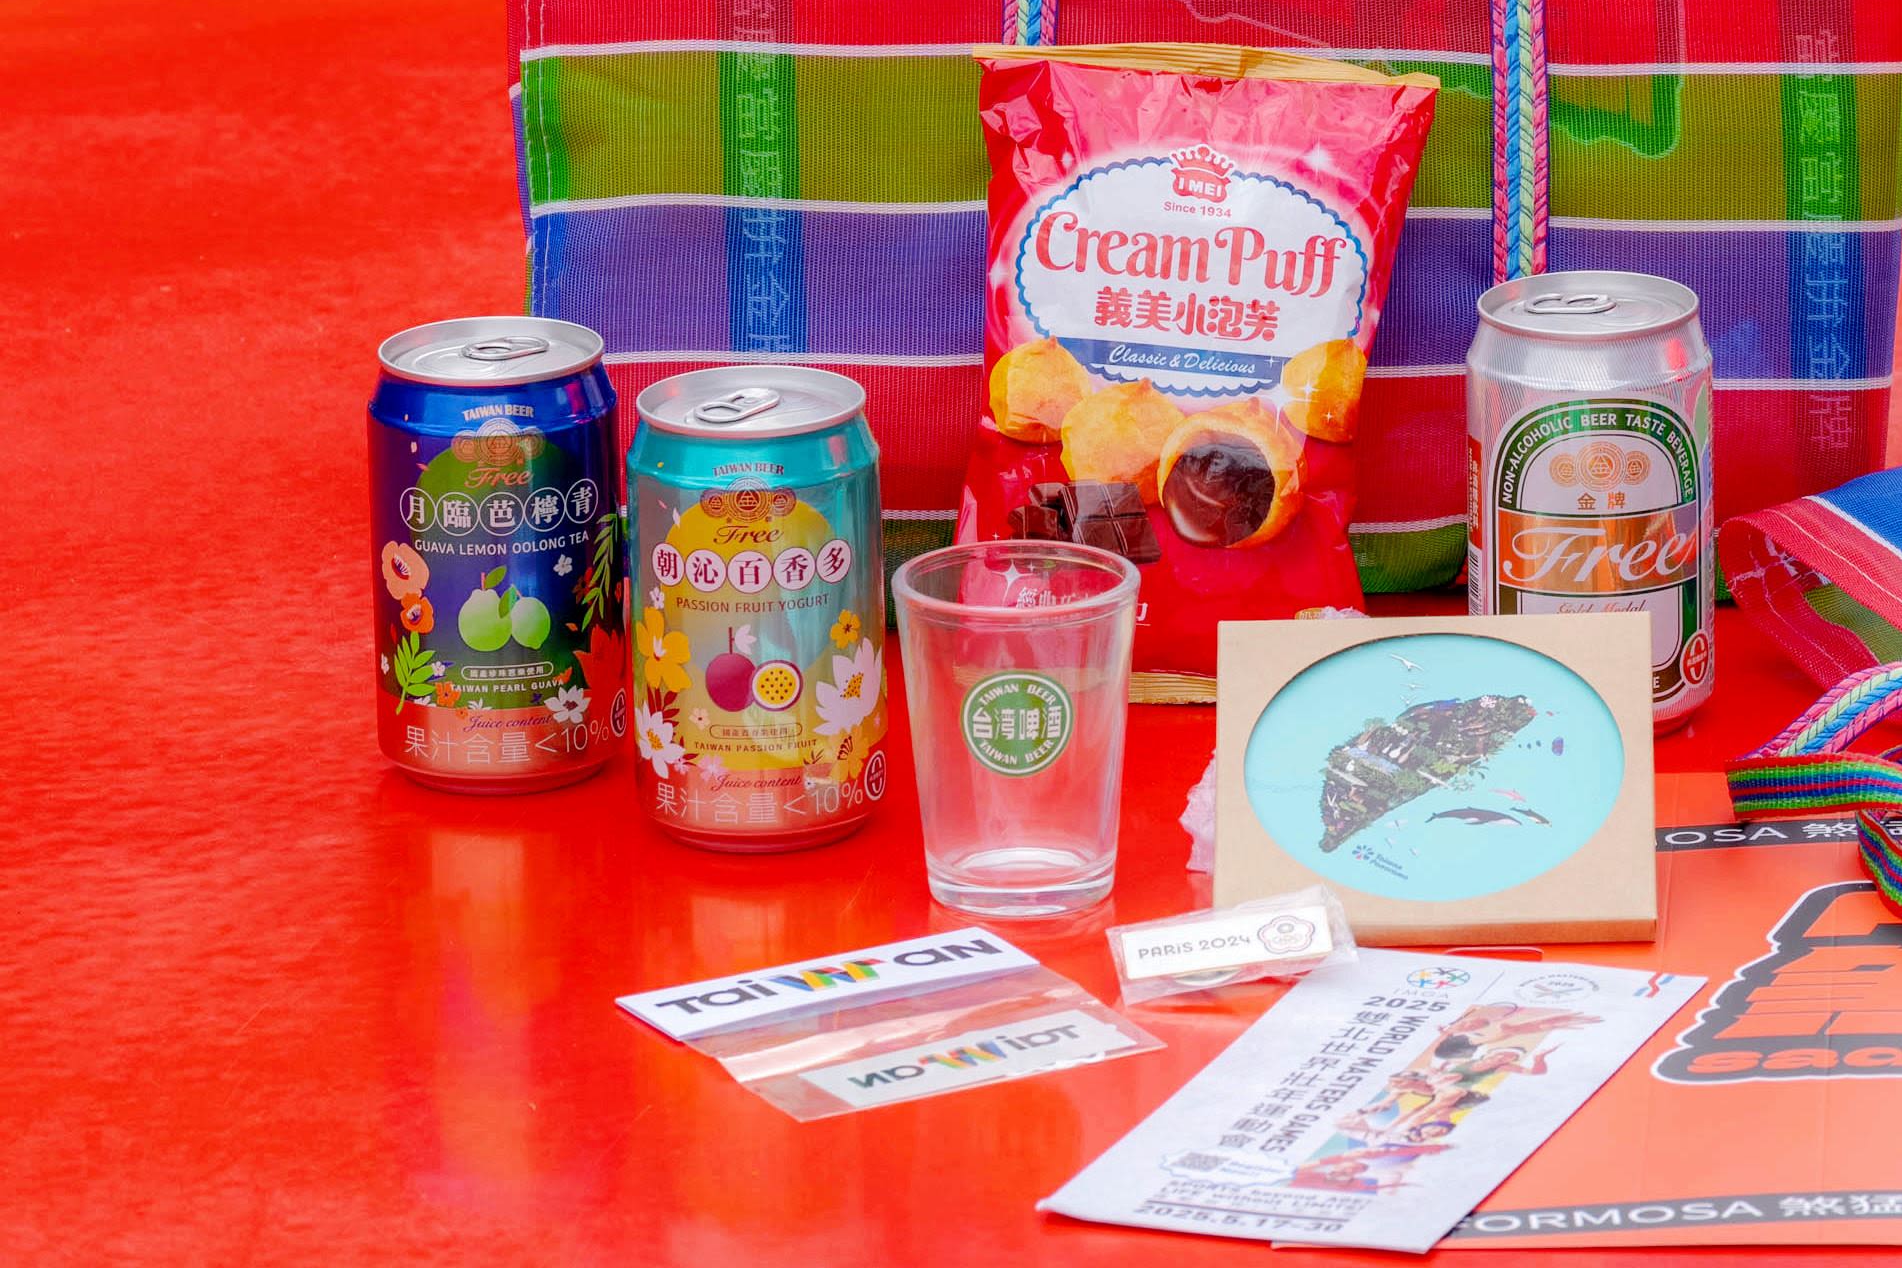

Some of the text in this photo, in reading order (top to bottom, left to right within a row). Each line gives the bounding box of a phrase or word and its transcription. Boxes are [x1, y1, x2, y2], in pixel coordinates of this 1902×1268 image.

[1163, 200, 1232, 218] Since 1934
[1036, 211, 1347, 298] Cream Puff
[1094, 285, 1281, 342] 義美小泡芙
[1108, 343, 1256, 375] Classic & Delicious
[462, 404, 534, 421] TAIWAN BEER
[713, 462, 785, 477] TAIWAN BEER
[1502, 416, 1573, 504] NON-ALCOHOLIC
[1581, 413, 1618, 428] BEER
[1625, 412, 1665, 436] TASTE
[1667, 430, 1694, 498] BEVERAGE
[464, 466, 535, 489] Free
[405, 486, 593, 528] 月臨芭檸青
[414, 531, 590, 556] GUAVA LEMON OOLONG TEA
[712, 524, 785, 545] Free
[1502, 524, 1697, 583] Free
[656, 547, 845, 585] 朝沁百香多
[676, 593, 830, 613] PASSION FRUIT YOGURT
[451, 678, 564, 693] TAIWAN PEARL GUAVA
[980, 683, 1057, 706] TAIWAN BEER
[695, 740, 731, 752] TAIWAN
[736, 744, 783, 753] PASSION
[979, 738, 1055, 765] TAIWAN BEER
[1198, 934, 1251, 952] 2024
[1362, 995, 1451, 1012] 2025
[1258, 1015, 1431, 1153] WORLD MASTERS GAMES
